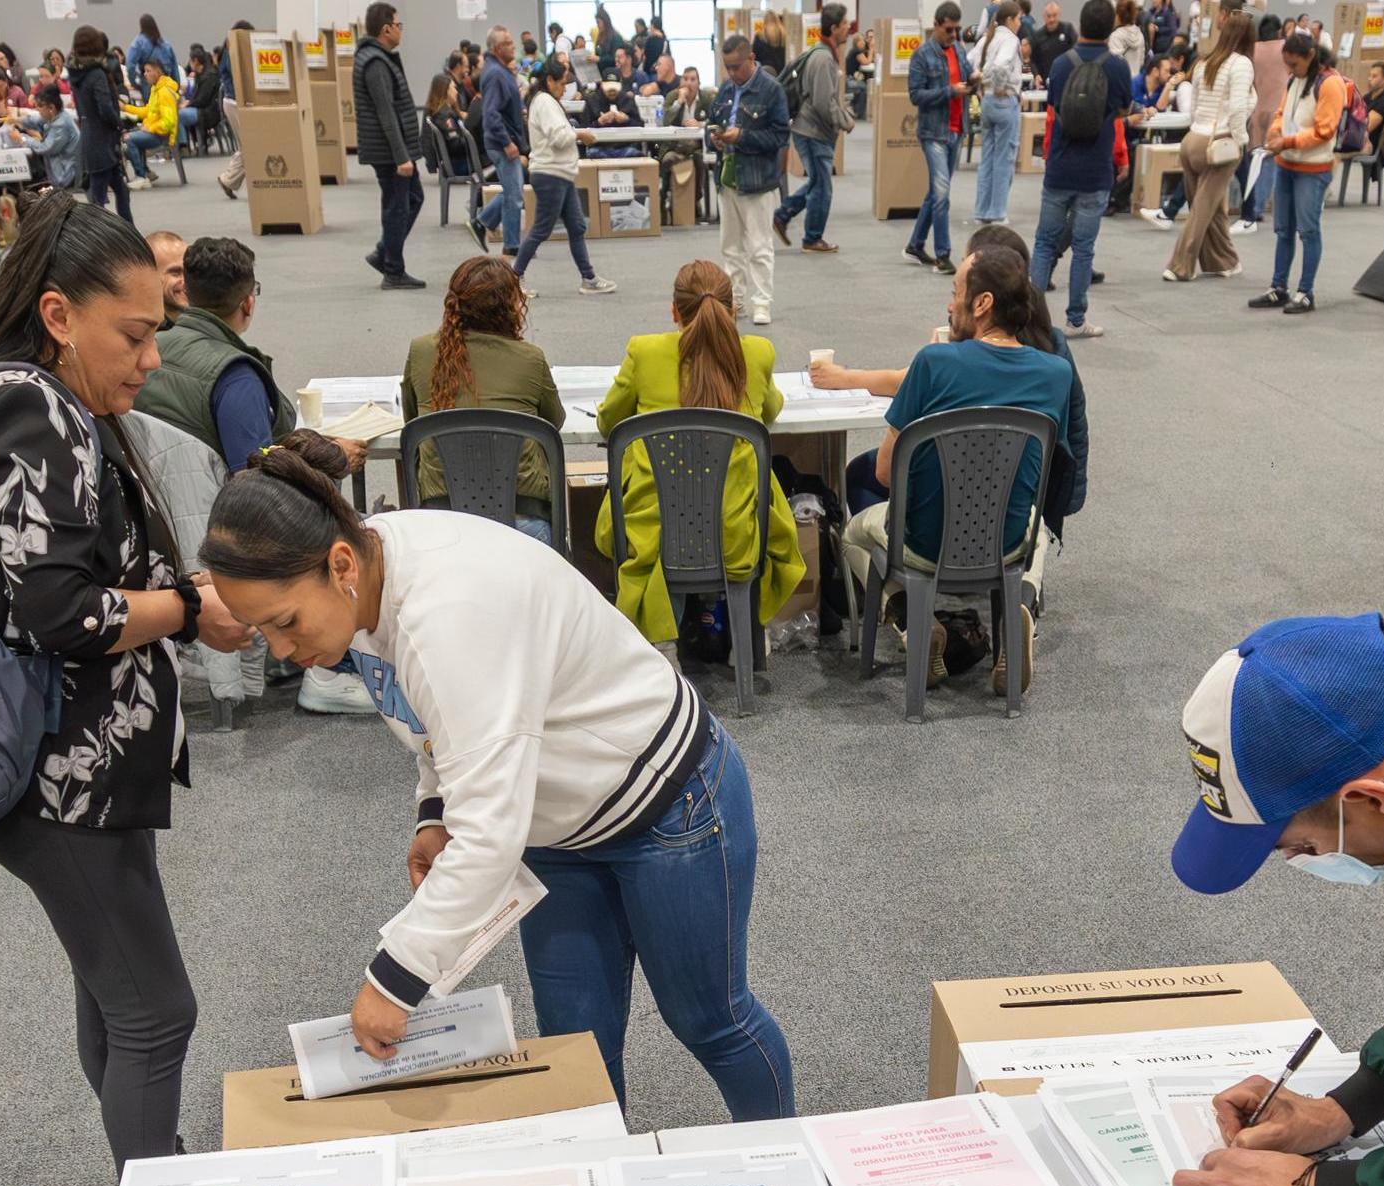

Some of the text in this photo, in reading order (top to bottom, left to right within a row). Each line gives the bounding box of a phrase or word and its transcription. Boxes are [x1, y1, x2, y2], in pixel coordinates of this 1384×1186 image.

[259, 52, 281, 64] NO
[1005, 972, 1225, 997] DEPOSITE SU VOTO AQUÍ
[483, 1050, 530, 1067] AQUÍ
[1137, 1053, 1213, 1064] CERRADA
[1228, 1048, 1272, 1057] URNA
[359, 1067, 399, 1082] NACIONAL
[881, 1126, 947, 1141] VOTO PARA
[912, 1137, 926, 1145] LA
[853, 1151, 935, 1168] COMUNIDADES
